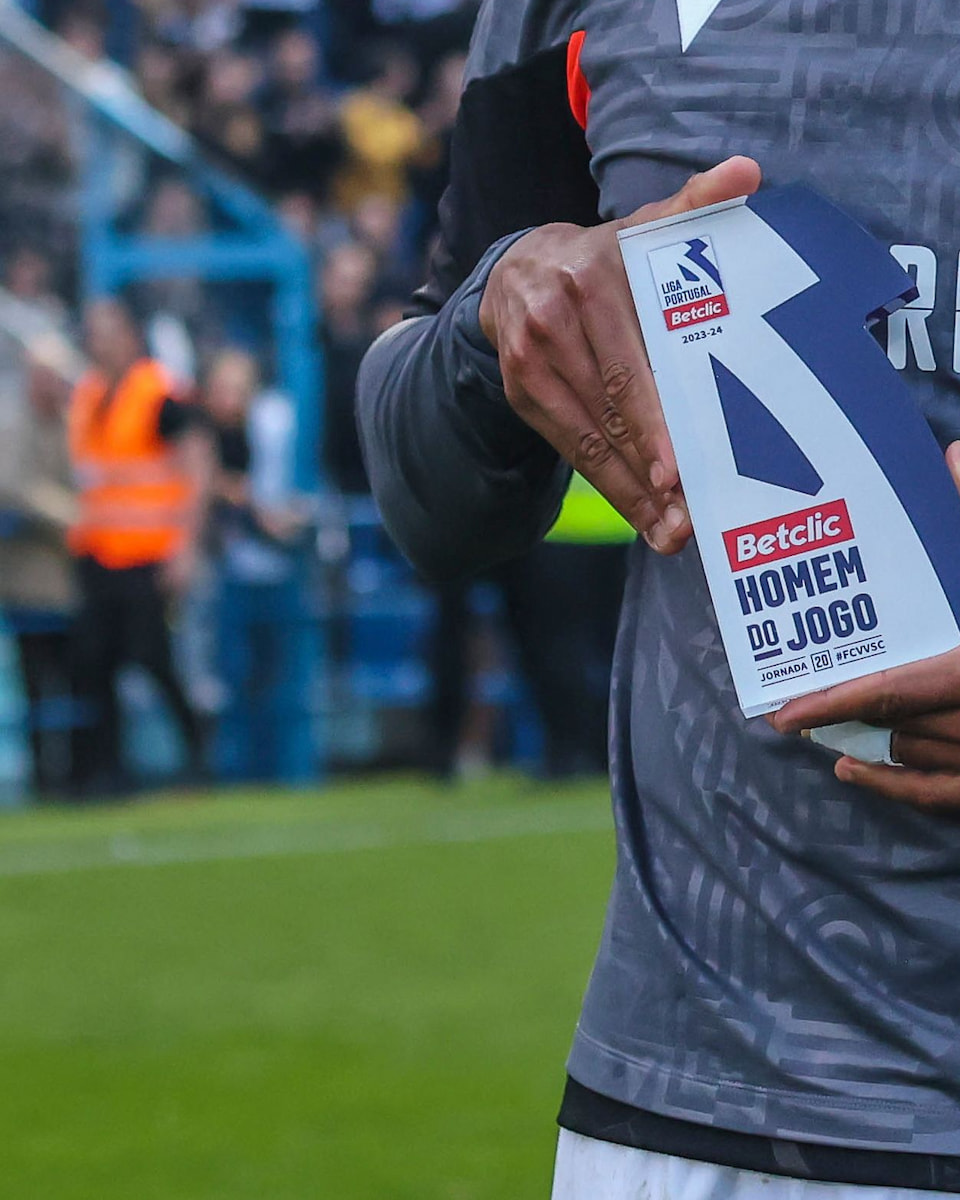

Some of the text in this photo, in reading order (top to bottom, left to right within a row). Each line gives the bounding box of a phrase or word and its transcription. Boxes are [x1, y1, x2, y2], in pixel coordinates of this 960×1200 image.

[661, 279, 683, 294] LIGA
[664, 284, 712, 307] PORTUGAL
[671, 301, 722, 326] Betclic
[681, 325, 723, 344] 2023-24
[736, 511, 842, 563] Betclic
[734, 545, 868, 616] HOMEM
[746, 593, 878, 651] DO JOGO
[760, 639, 886, 682] JORNADA 20 #FCVVSC
